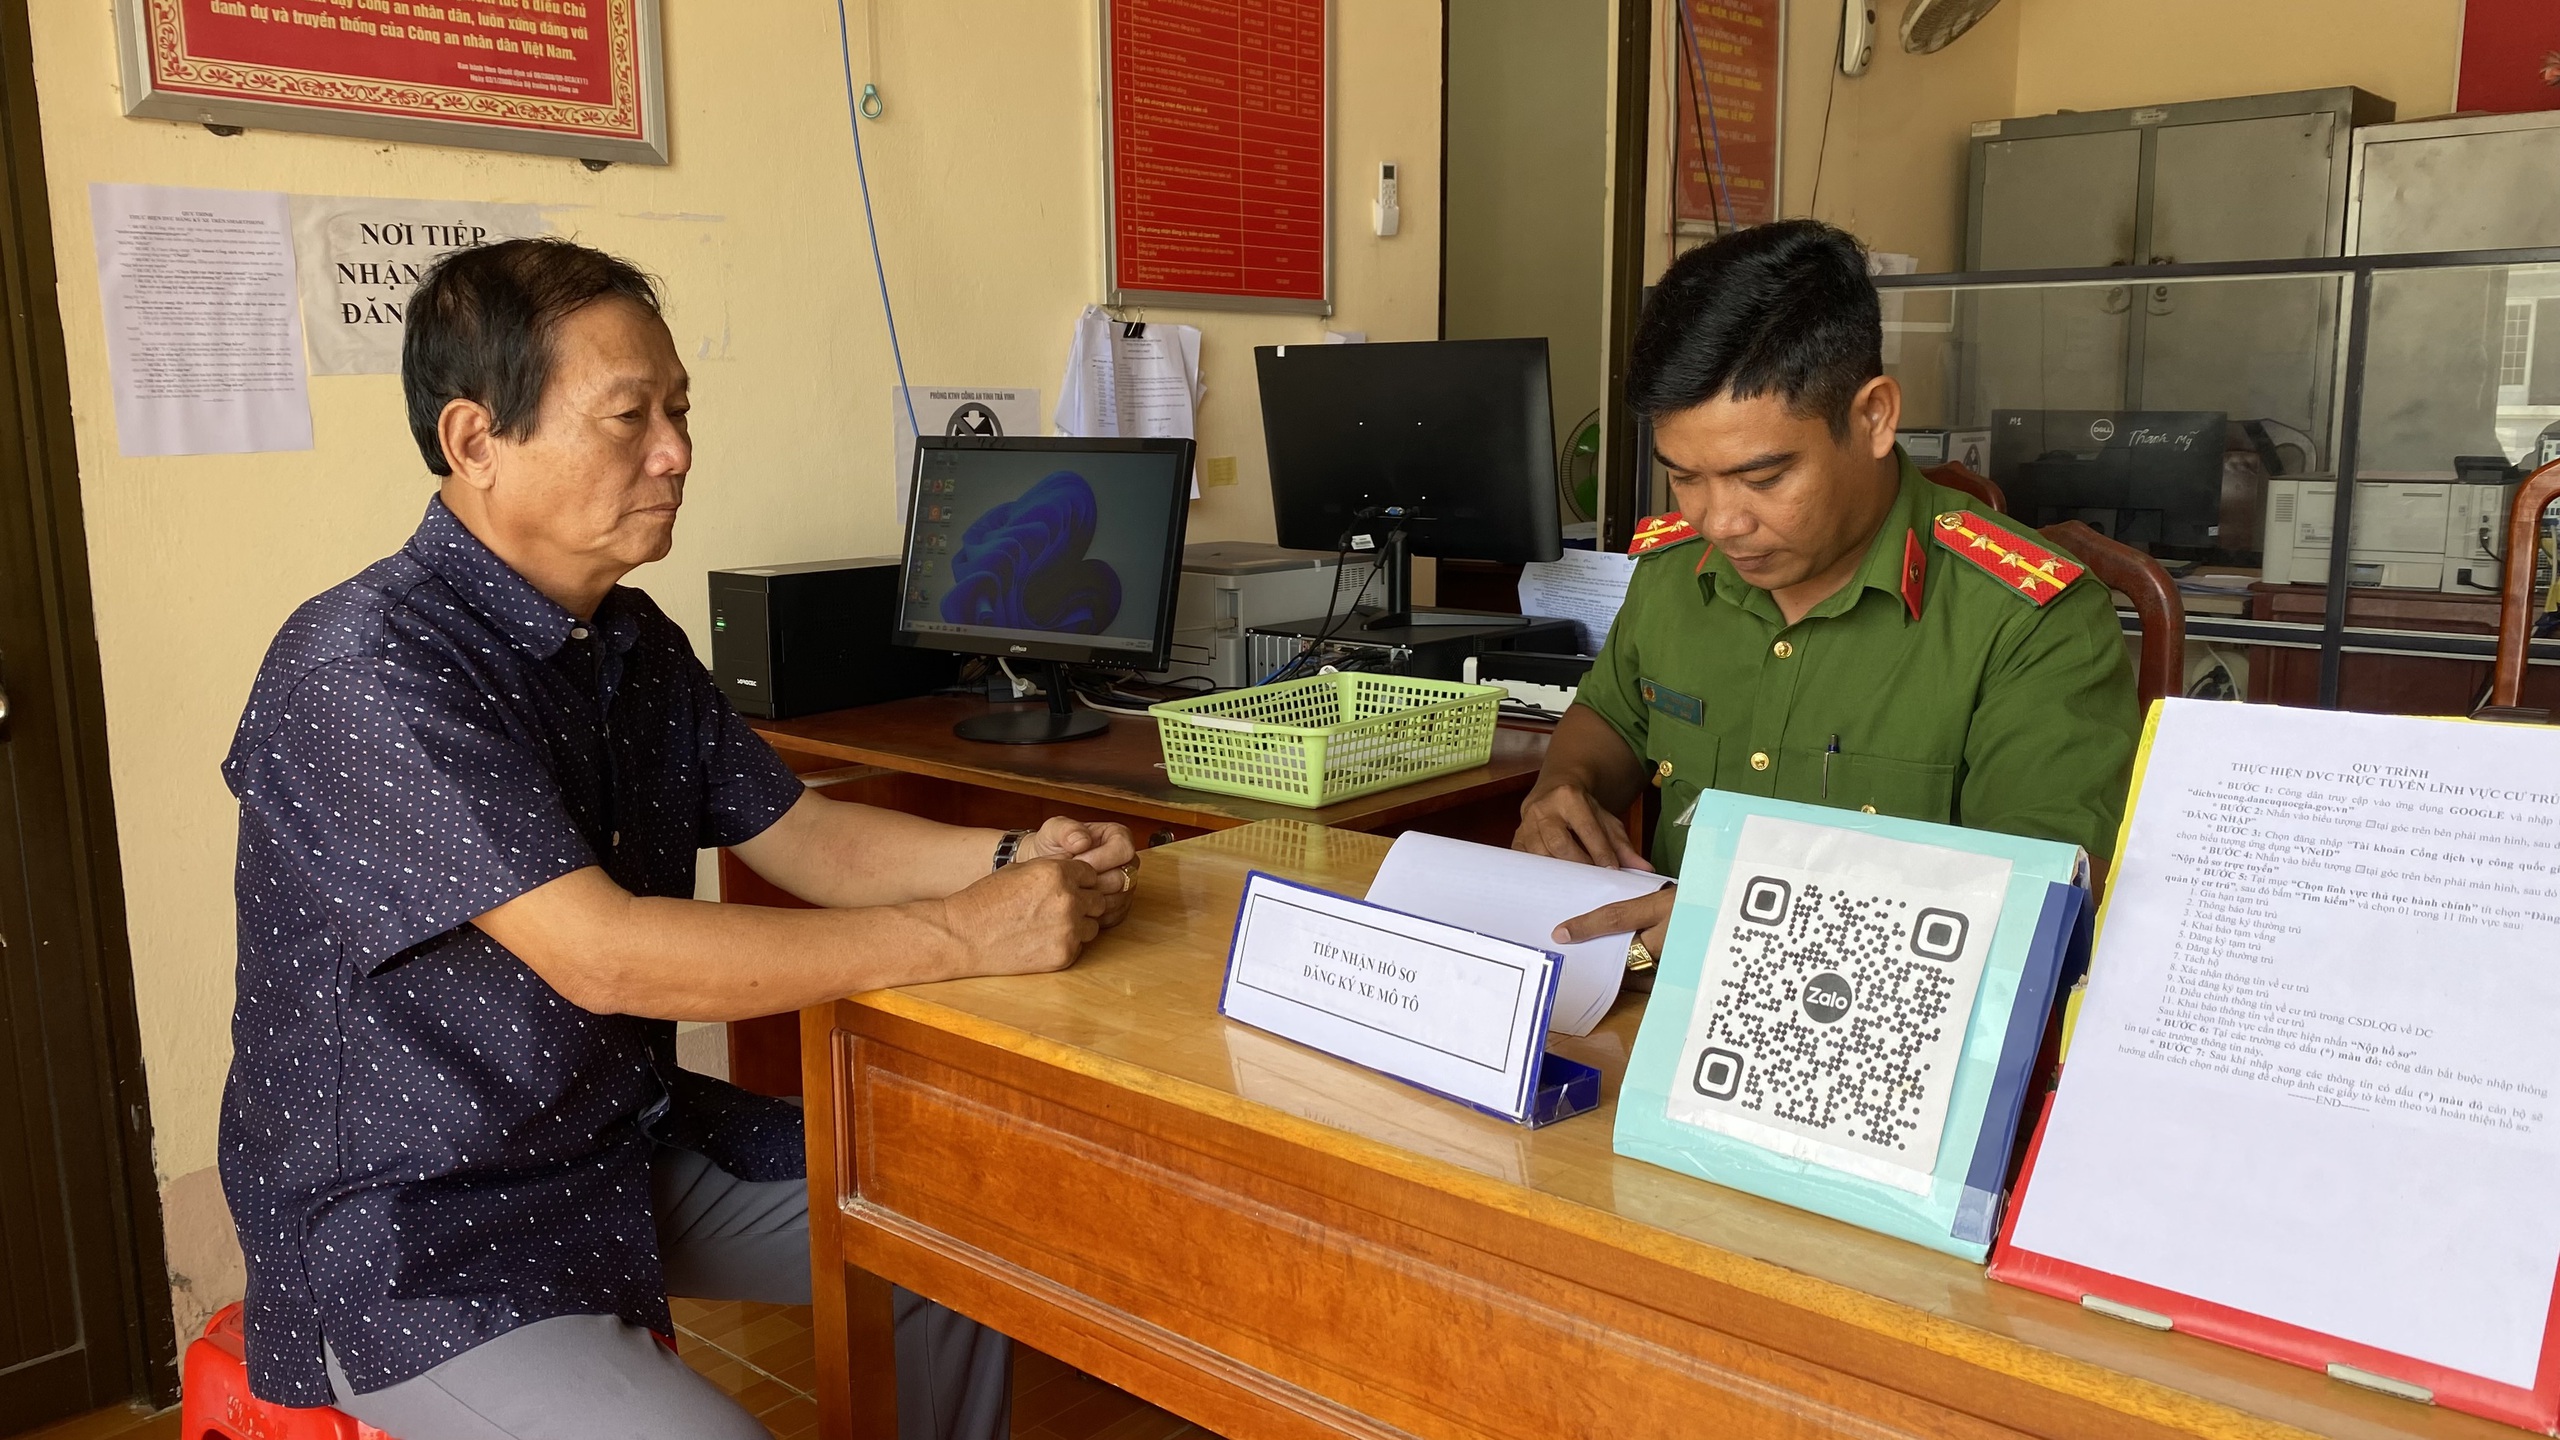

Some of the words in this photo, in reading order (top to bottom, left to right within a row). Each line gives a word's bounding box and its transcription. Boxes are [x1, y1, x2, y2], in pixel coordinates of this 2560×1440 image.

[393, 2, 409, 15] an
[413, 4, 444, 20] nhân
[448, 7, 475, 26] dân,
[478, 12, 504, 28] luôn
[508, 17, 537, 34] xứng
[540, 21, 568, 39] đáng
[571, 27, 588, 40] với
[563, 1, 587, 18] Chủ
[210, 0, 247, 17] danh
[250, 4, 269, 23] dự
[272, 7, 289, 23] và
[293, 10, 336, 29] truyền
[339, 15, 377, 36] thống
[380, 20, 404, 38] của
[407, 24, 440, 44] Công
[444, 31, 460, 46] an
[463, 33, 493, 50] nhân
[496, 37, 519, 53] dân
[521, 40, 544, 58] Việt
[546, 44, 577, 61] Nam.
[359, 221, 414, 246] NƠI
[421, 220, 486, 247] TIẾP
[336, 260, 420, 291] NHẬN
[2230, 762, 2268, 775] THỰC
[2270, 766, 2302, 778] HIỆN
[2305, 770, 2334, 781] DVC
[2337, 773, 2375, 786] TRỰC
[2378, 777, 2426, 790] TUYẾN
[2429, 782, 2464, 794] LĨNH
[2469, 786, 2500, 799] VỰC
[2503, 790, 2527, 800] CƯ
[2352, 762, 2391, 776] QUY
[2394, 764, 2429, 779] TRÌNH
[2227, 781, 2260, 792] BƯỚC
[2277, 786, 2302, 799] Công
[2306, 790, 2323, 799] dân
[2327, 793, 2347, 804] truy
[2351, 795, 2368, 806] cập
[2373, 798, 2391, 807] vào
[2395, 800, 2414, 811] ứng
[2418, 802, 2443, 815] dụng
[2449, 806, 2504, 819] GOOGLE
[2510, 812, 2522, 821] và
[2527, 814, 2553, 826] nhập
[2175, 830, 2197, 840] chọn
[2199, 832, 2218, 843] biểu
[2220, 836, 2246, 848] tượng
[2248, 839, 2265, 850] ứng
[2267, 841, 2291, 854] dụng
[2197, 854, 2209, 864] hồ
[2223, 860, 2244, 870] trực
[2199, 888, 2215, 898] Gia
[2217, 891, 2234, 901] hạn
[2236, 895, 2253, 904] tạm
[2203, 867, 2236, 879] BƯỚC
[2251, 873, 2265, 884] Tại
[2267, 878, 2288, 889] mục
[2326, 884, 2345, 894] lĩnh
[2349, 889, 2368, 898] vực
[2371, 890, 2388, 900] thủ
[2391, 894, 2408, 904] tục
[2411, 895, 2437, 907] hành
[2480, 904, 2491, 914] tít
[2494, 905, 2520, 918] chọn
[2197, 899, 2225, 912] Thông
[2246, 906, 2262, 916] lưu
[2188, 931, 2212, 944] Đăng
[2228, 939, 2245, 948] tạm
[1313, 940, 1340, 958] TIẾP
[1340, 949, 1376, 971] NHẬN
[1378, 957, 1397, 977] HỒ
[1398, 966, 1418, 983] SƠ
[2183, 953, 2205, 964] Tách
[2207, 957, 2219, 968] hộ
[2185, 942, 2209, 955] Đăng
[2225, 949, 2258, 964] thường
[1303, 964, 1336, 986] ĐĂNG
[1338, 974, 1358, 992] KÝ
[1357, 983, 1375, 999] XE
[1376, 985, 1399, 1006] MÔ
[1401, 993, 1420, 1012] TÔ
[1806, 986, 1848, 1010] Zalo
[2179, 986, 2201, 998] Điều
[2203, 991, 2228, 1002] chỉnh
[2230, 995, 2257, 1010] thông
[2259, 1000, 2272, 1010] tin
[2275, 1002, 2286, 1012] về
[2288, 1007, 2301, 1015] cư
[2319, 1011, 2344, 1025] trong
[2347, 1016, 2397, 1032] CSDLQG
[2399, 1023, 2412, 1034] về
[2414, 1026, 2433, 1038] DC
